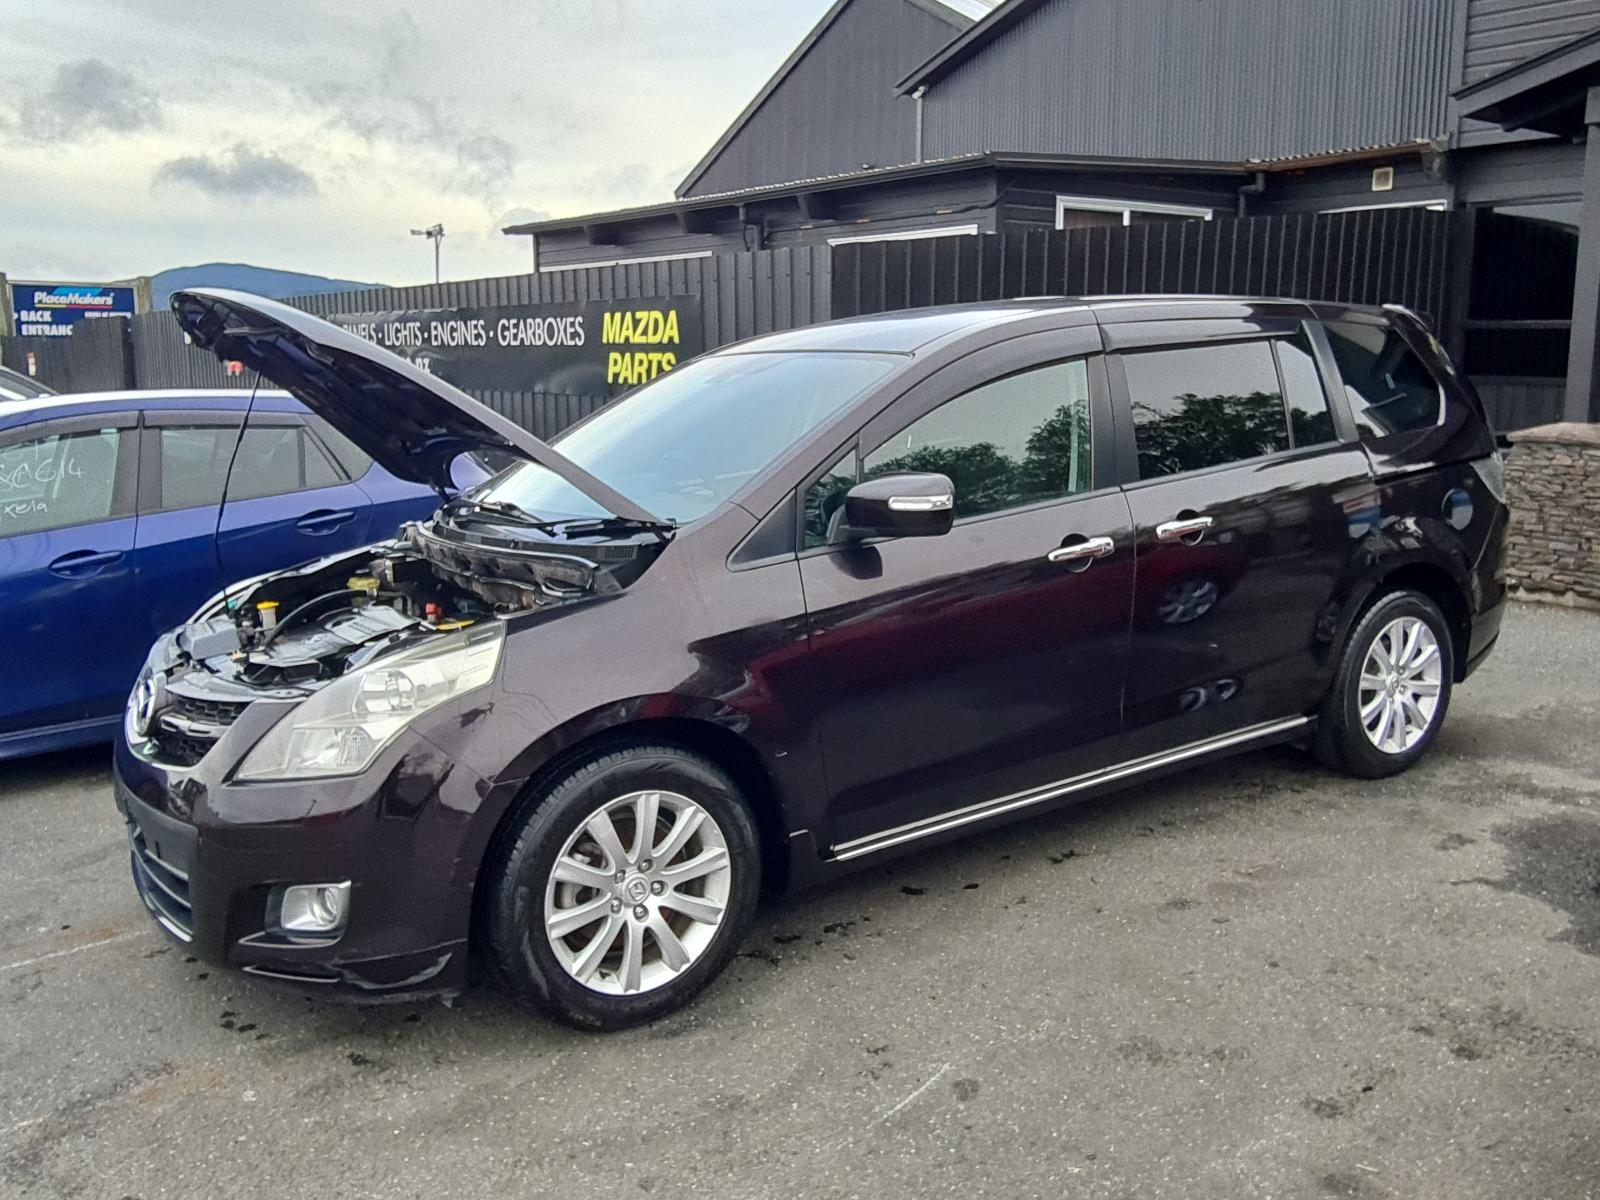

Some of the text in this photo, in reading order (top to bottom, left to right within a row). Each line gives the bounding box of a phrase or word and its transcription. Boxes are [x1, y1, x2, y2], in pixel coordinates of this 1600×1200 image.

[33, 291, 113, 305] PlaceMakers
[20, 310, 52, 322] BACK
[602, 309, 680, 344] MAZDA
[21, 324, 74, 336] ENTRANC
[384, 321, 422, 346] LIGHTS
[430, 319, 487, 347] ENGINES
[497, 316, 585, 346] GEARBOXES
[607, 351, 677, 385] PARTS
